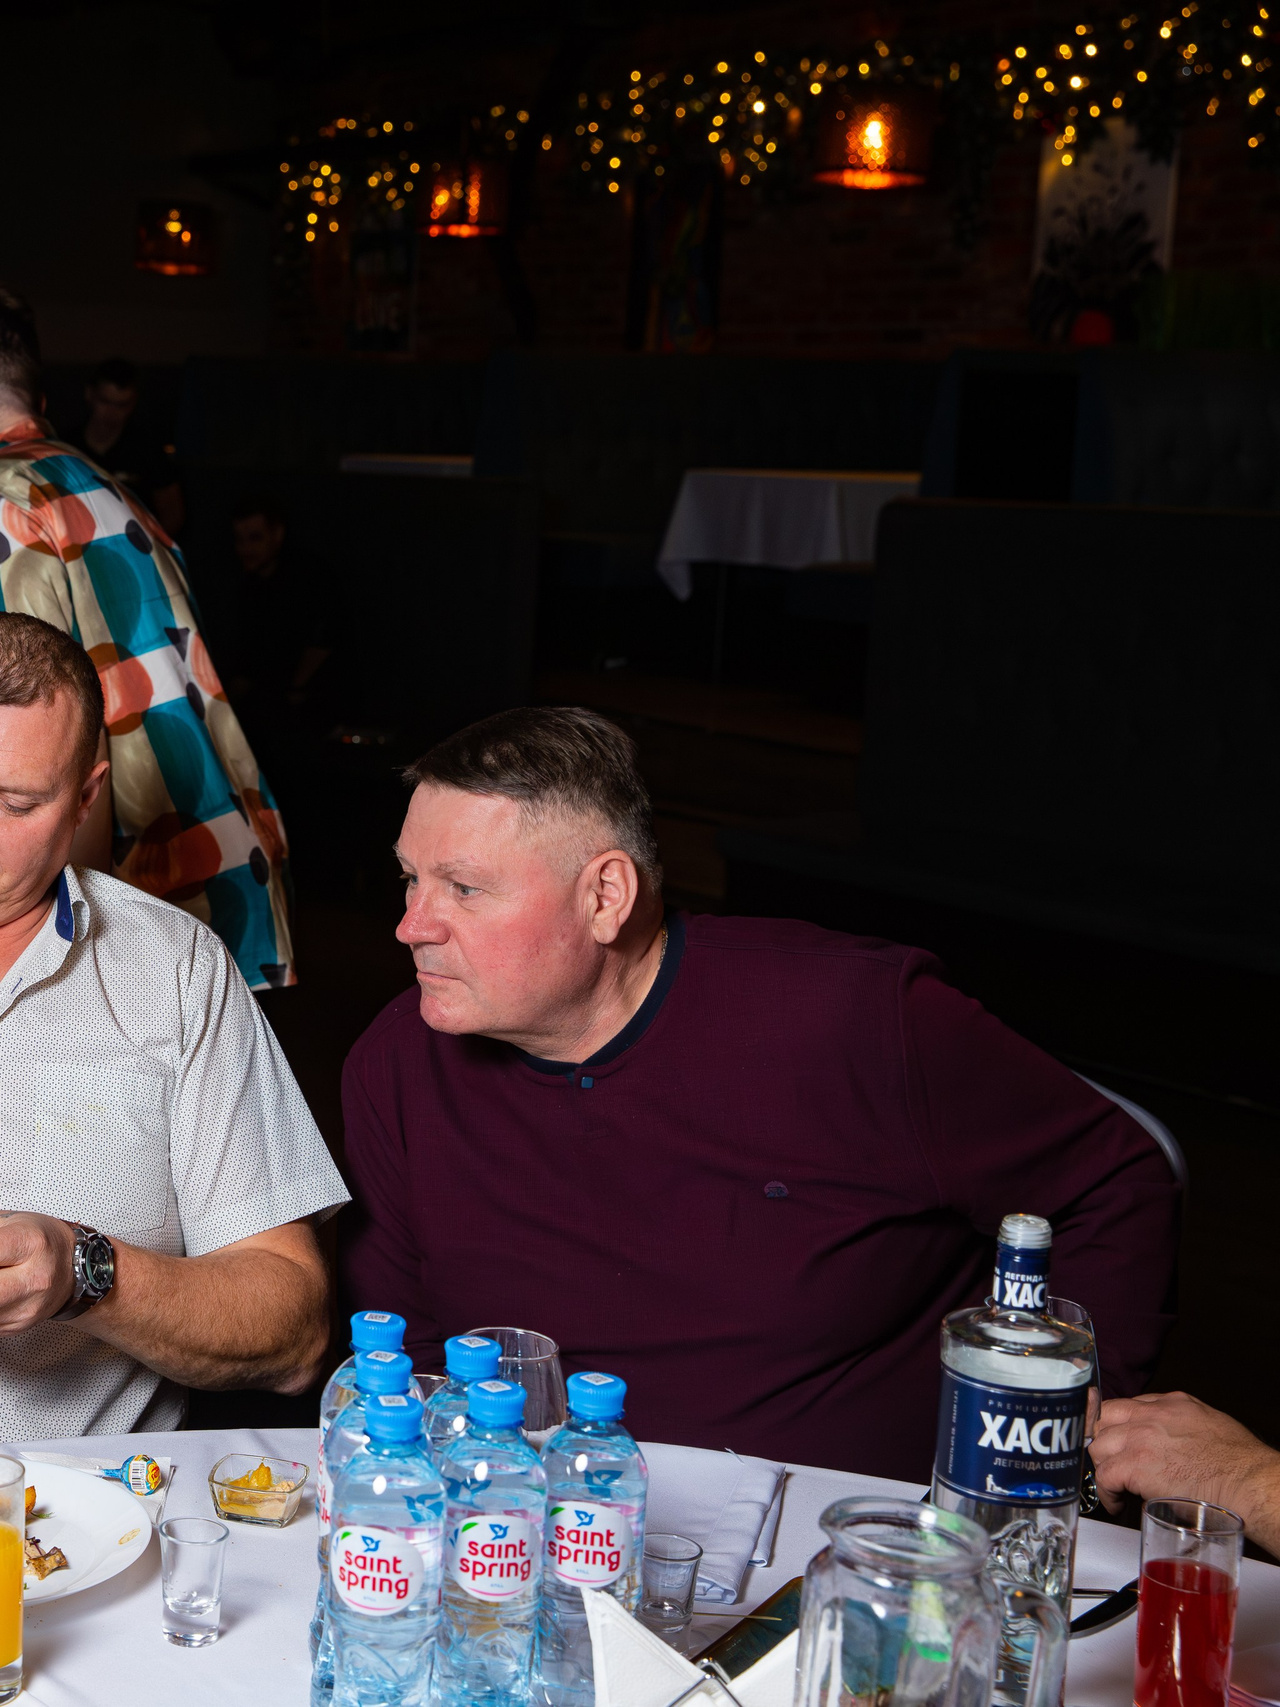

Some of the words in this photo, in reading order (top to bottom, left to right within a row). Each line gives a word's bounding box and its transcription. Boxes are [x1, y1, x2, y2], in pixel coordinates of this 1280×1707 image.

[1004, 1271, 1043, 1283] ЛЕГЕНДА
[1002, 1279, 1048, 1308] ХАС
[987, 1399, 1049, 1413] PREMIUM
[977, 1411, 1085, 1455] ХАСКИ
[993, 1457, 1042, 1471] ЛЕГЕНДА
[554, 1525, 616, 1547] saint
[467, 1539, 527, 1559] saint
[547, 1540, 621, 1572] spring
[344, 1550, 403, 1574] saint
[458, 1557, 531, 1581] spring
[338, 1566, 409, 1599] spring
